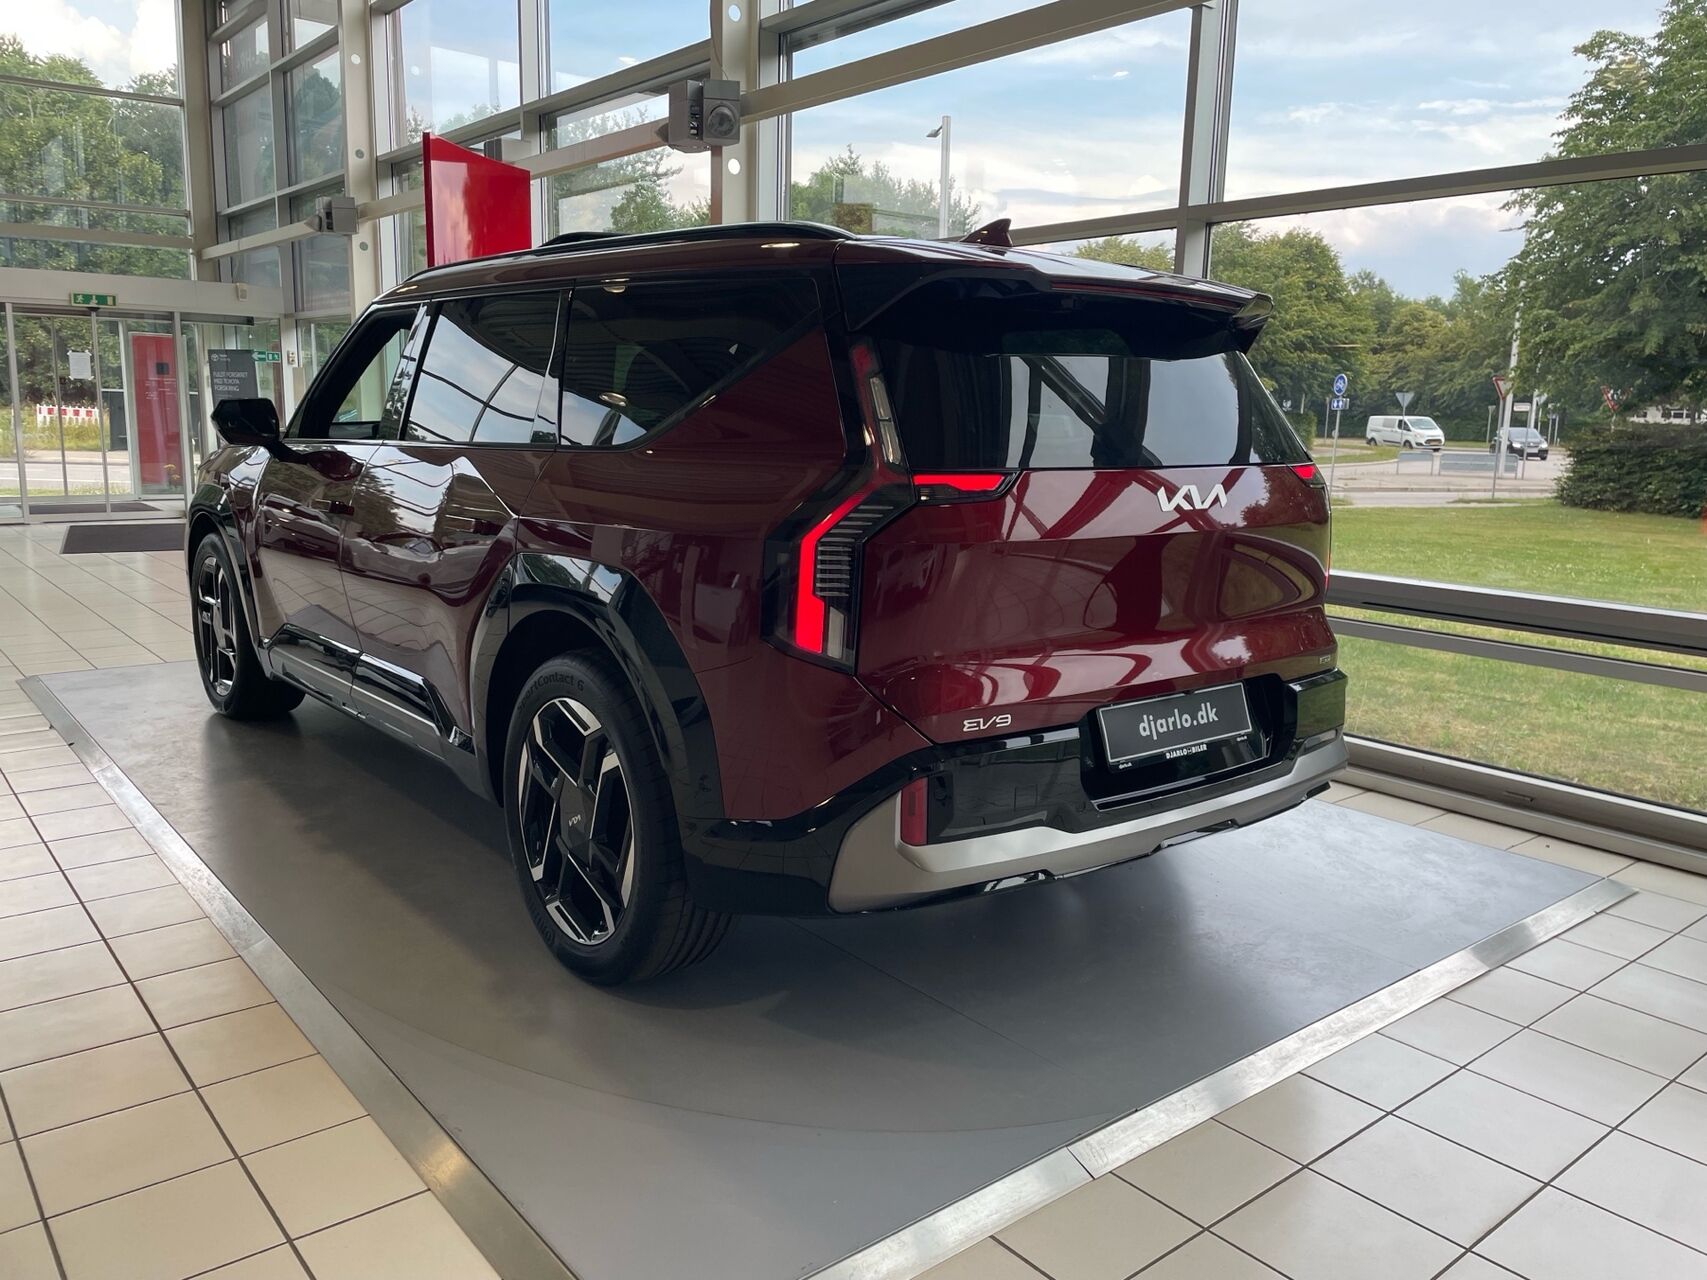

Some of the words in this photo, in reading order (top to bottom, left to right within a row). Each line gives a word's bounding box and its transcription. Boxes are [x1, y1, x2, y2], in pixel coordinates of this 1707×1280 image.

[1157, 484, 1228, 512] KIA
[577, 679, 585, 692] 6
[963, 714, 1012, 732] EV9
[1139, 702, 1219, 740] djarlo.dk
[1166, 746, 1188, 759] DJARLO
[1191, 744, 1207, 754] BILER
